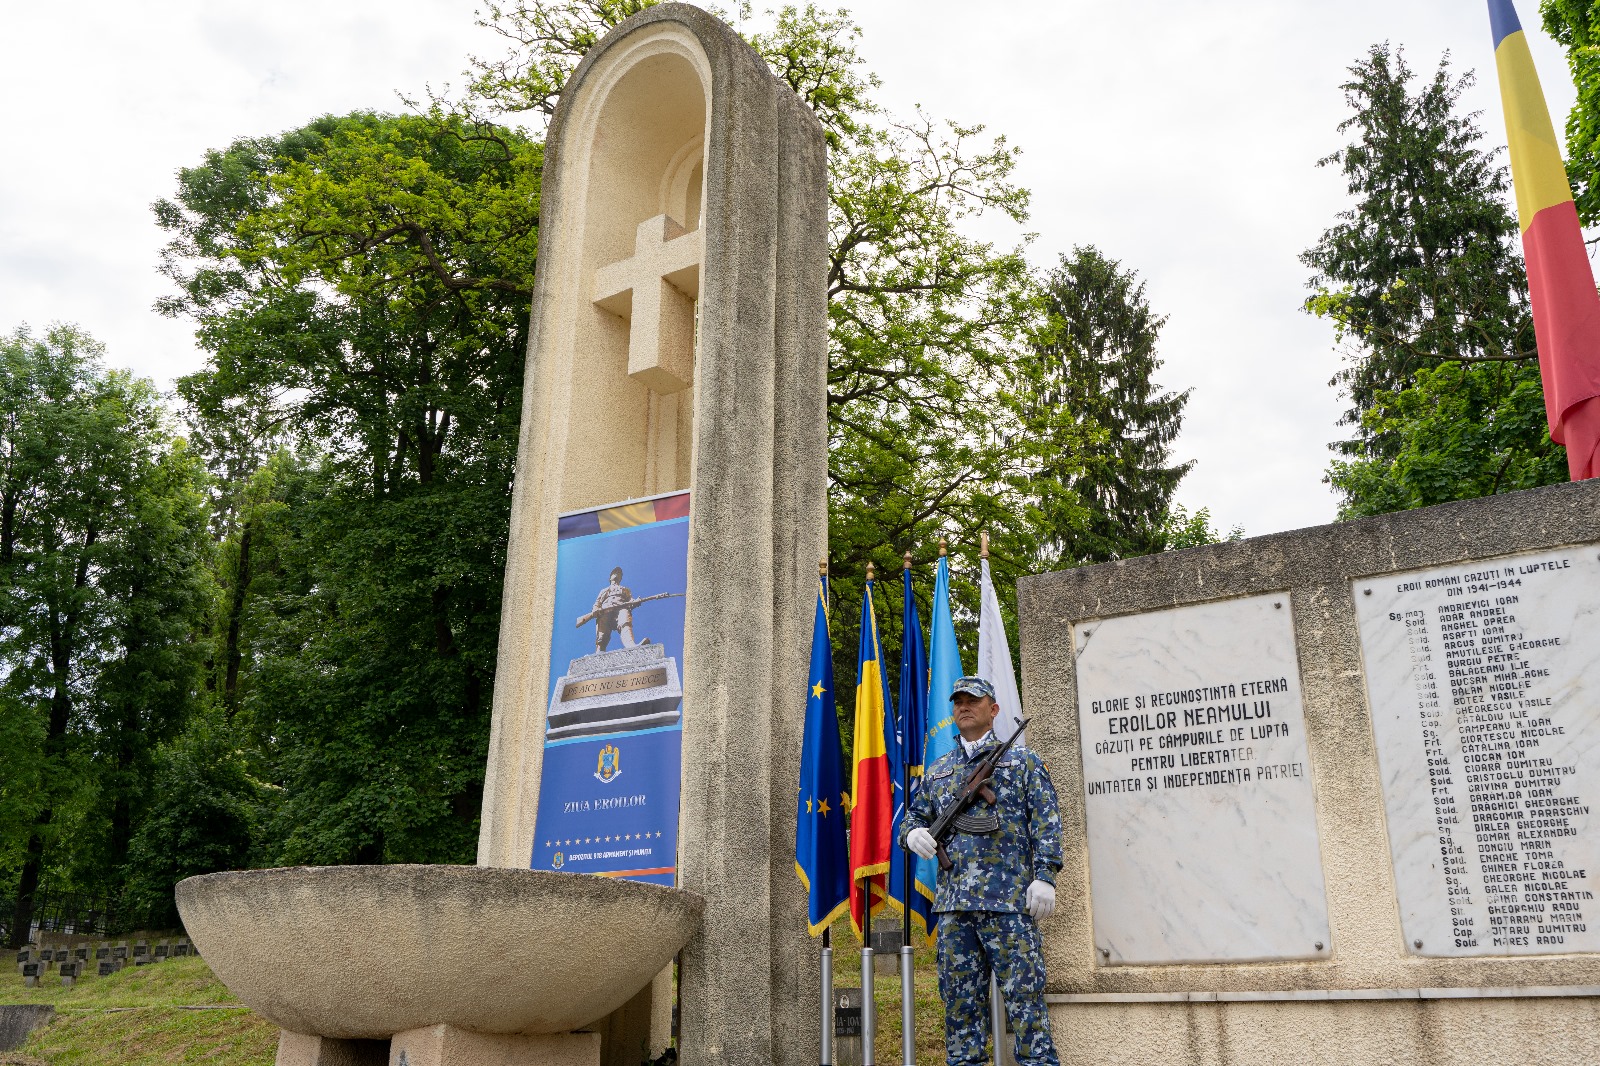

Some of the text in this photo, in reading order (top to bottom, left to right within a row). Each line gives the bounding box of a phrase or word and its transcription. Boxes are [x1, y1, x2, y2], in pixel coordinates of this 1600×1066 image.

[1484, 616, 1515, 626] OPREA
[1092, 698, 1129, 714] GLORIE
[1135, 695, 1145, 711] ȘI
[1109, 701, 1271, 734] EROILOR NEAMULUI
[1096, 738, 1134, 756] CĂZUȚI
[1140, 738, 1153, 750] PE
[1230, 728, 1244, 741] DE
[1132, 755, 1174, 771] PENTRU
[1088, 778, 1141, 795] UNITATEA
[1147, 777, 1157, 792] ȘI
[1257, 763, 1303, 780] PATRIEI
[564, 795, 646, 813] ZIUA EROILOR
